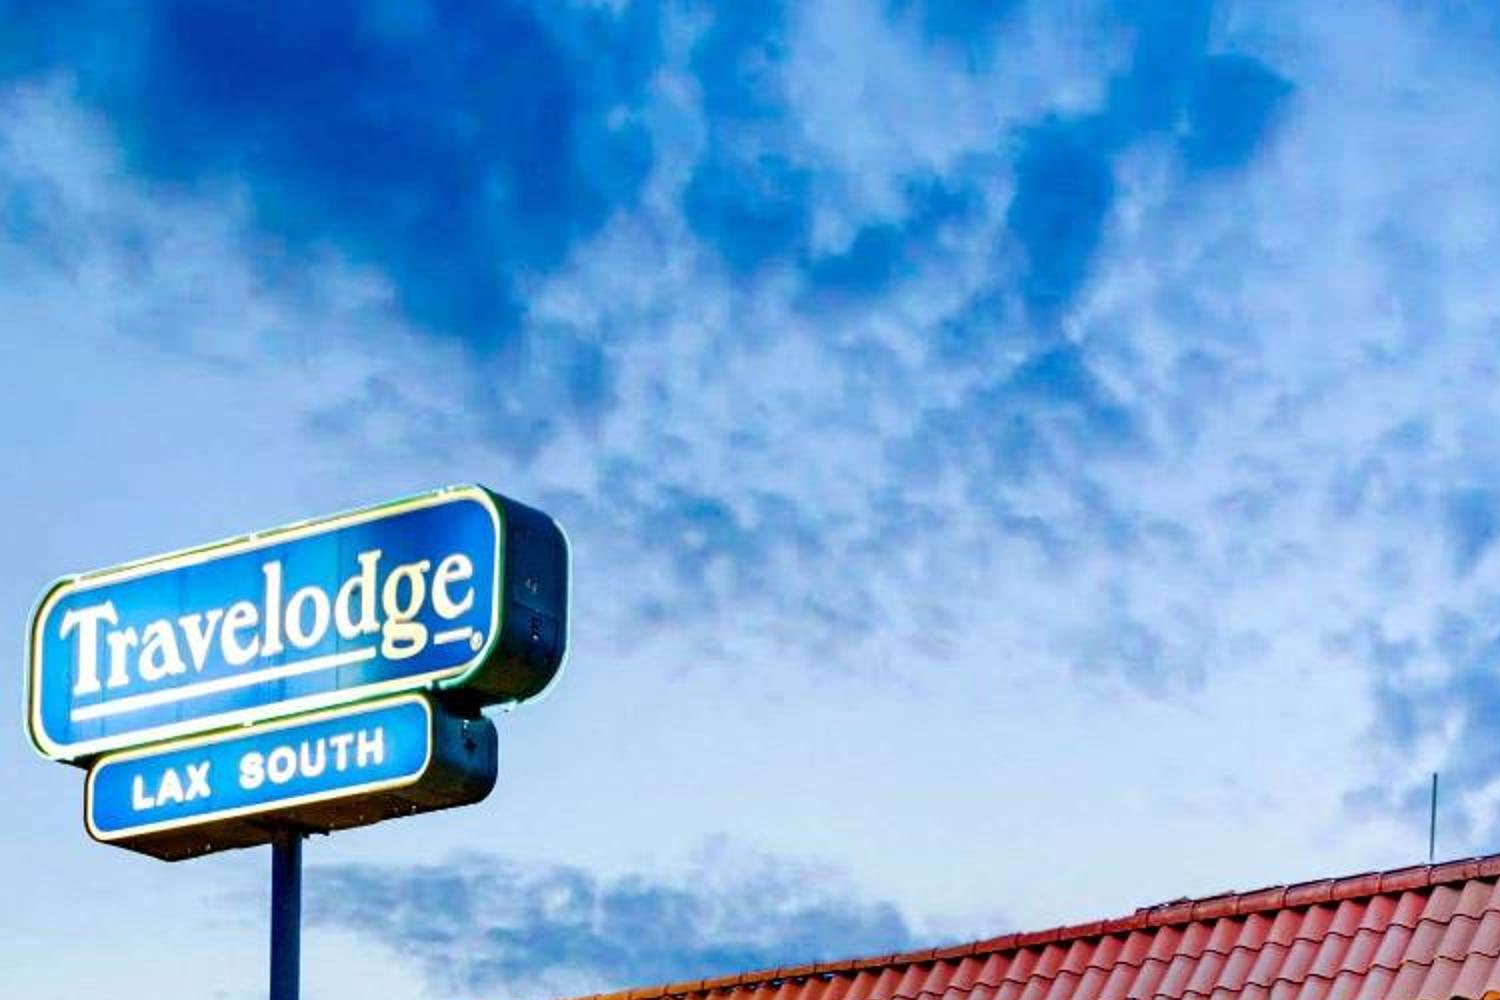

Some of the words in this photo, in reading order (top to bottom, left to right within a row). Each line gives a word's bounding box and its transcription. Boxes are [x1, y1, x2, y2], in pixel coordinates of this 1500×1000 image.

[59, 549, 475, 696] Travelodge
[132, 760, 212, 812] LAX
[238, 727, 385, 790] SOUTH
